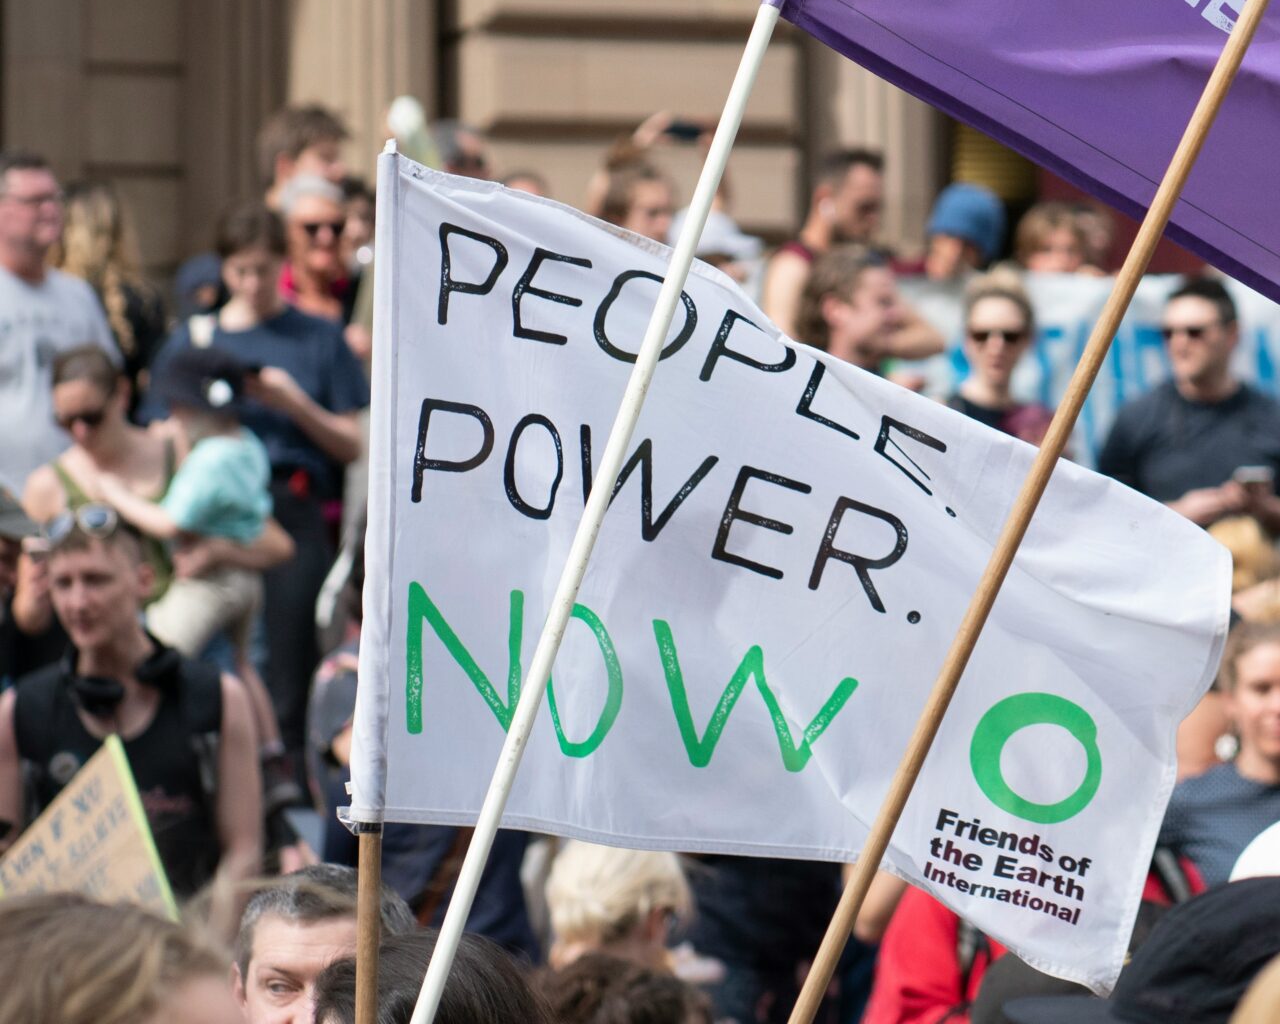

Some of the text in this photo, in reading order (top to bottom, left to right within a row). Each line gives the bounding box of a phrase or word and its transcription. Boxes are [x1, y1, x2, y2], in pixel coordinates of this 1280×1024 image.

[438, 221, 958, 518] PEOPLE.
[411, 398, 922, 625] POWER.
[406, 581, 859, 773] NOW
[922, 862, 1082, 926] International
[929, 836, 1085, 901] the Earth
[934, 808, 1093, 878] Friends of
